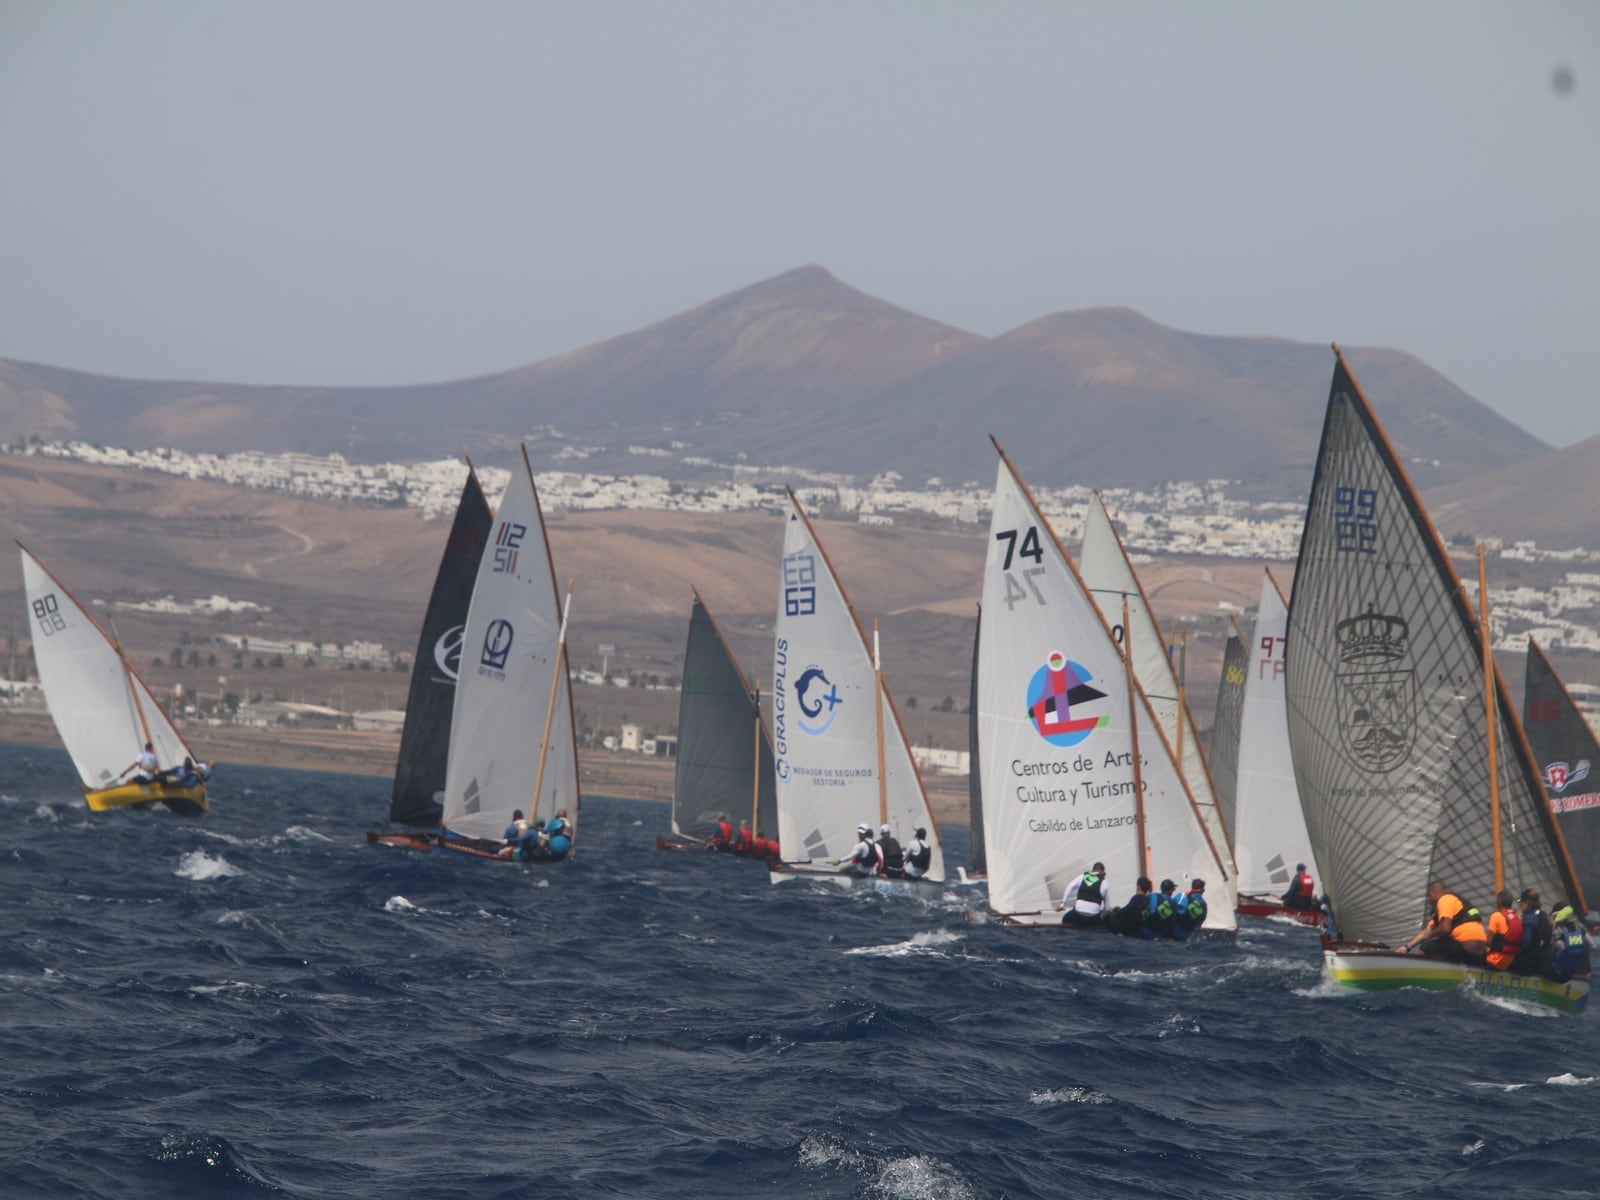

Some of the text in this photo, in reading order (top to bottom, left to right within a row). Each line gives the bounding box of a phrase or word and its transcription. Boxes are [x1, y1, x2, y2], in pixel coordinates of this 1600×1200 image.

[1335, 487, 1377, 519] 99
[496, 521, 527, 549] 112
[996, 526, 1043, 570] 74
[32, 593, 58, 619] 80
[785, 587, 816, 616] 63
[776, 638, 788, 755] GRACIPLUS
[824, 768, 832, 777] DE
[834, 768, 873, 777] SEGUROS
[1012, 759, 1069, 777] Centros
[1073, 754, 1093, 772] de
[1016, 786, 1066, 803] Cultura
[1070, 788, 1077, 806] y
[1029, 814, 1147, 832] Cabildo de Lanzarot
